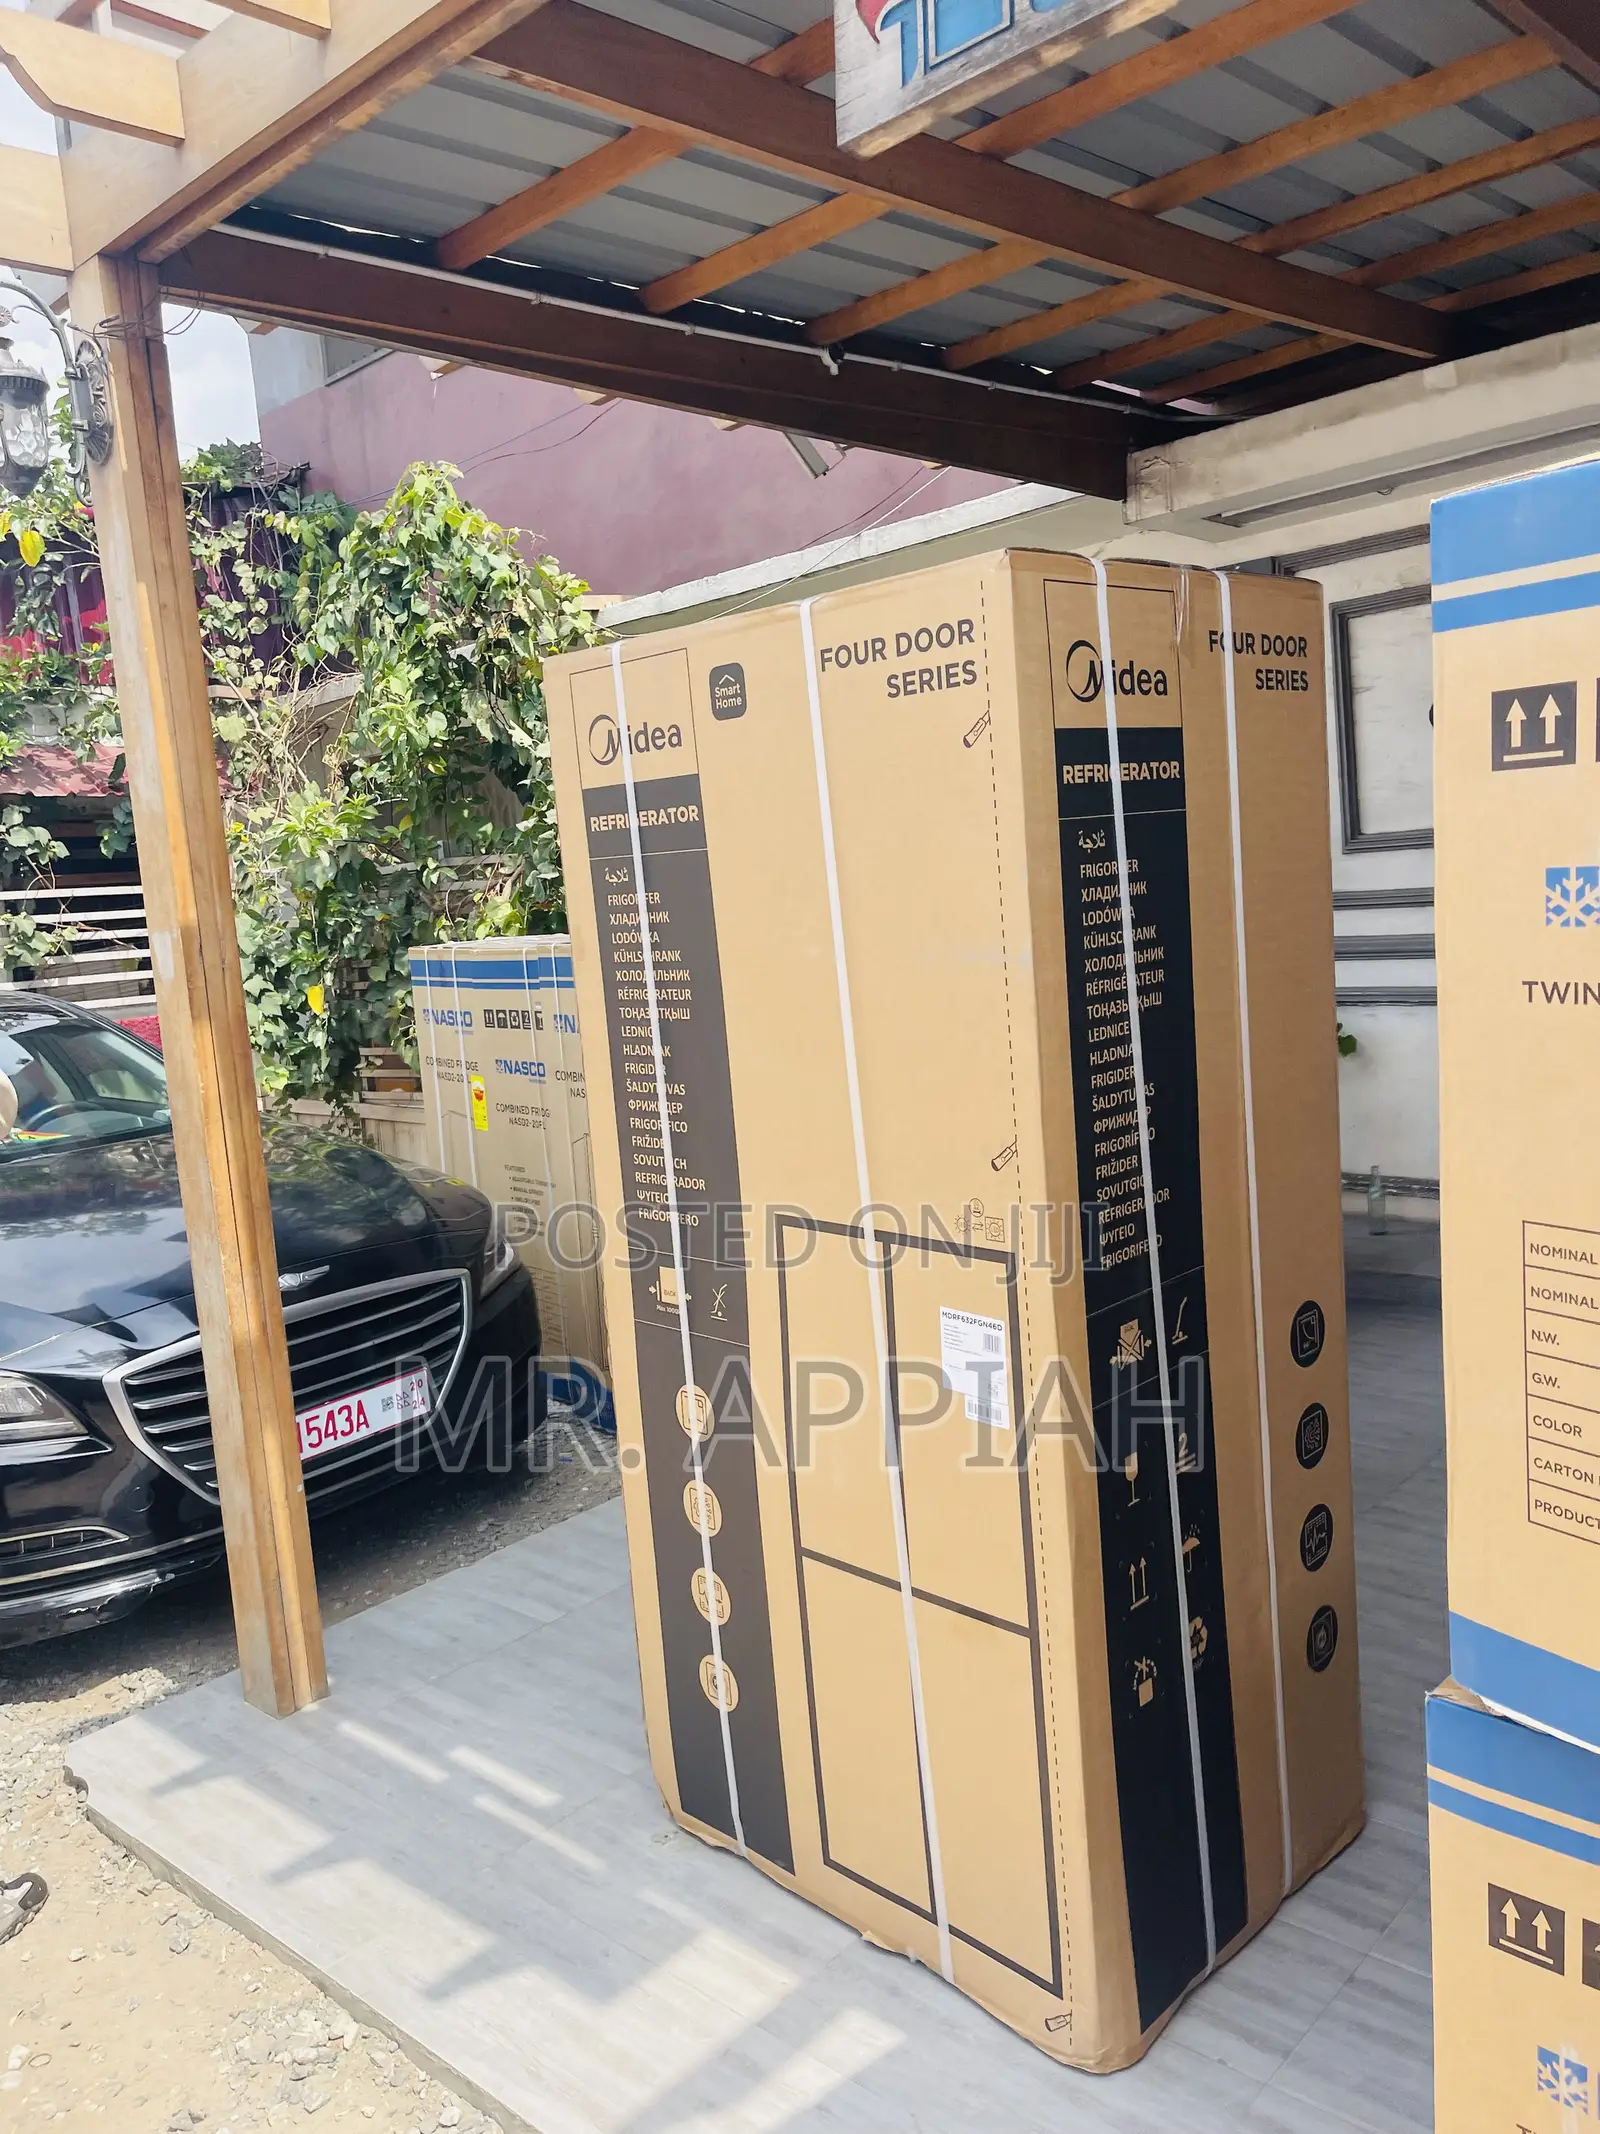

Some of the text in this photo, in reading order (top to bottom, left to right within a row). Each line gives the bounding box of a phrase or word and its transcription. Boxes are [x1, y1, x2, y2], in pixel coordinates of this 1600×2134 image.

[820, 618, 975, 672] FOUR DOOR
[1261, 634, 1307, 658] DOOR
[887, 660, 977, 698] SERIES
[1066, 640, 1168, 702] Midea
[1256, 668, 1309, 691] SERIES
[714, 682, 741, 699] Smart
[715, 694, 743, 710] Home
[588, 714, 683, 766] Midea
[1062, 761, 1180, 785] REFRIERATOR
[590, 804, 700, 833] REFRIERATOR
[1080, 859, 1139, 878] FRIGORER
[1081, 881, 1148, 903] ХЛАДИНИК
[1082, 904, 1136, 926] LODÓWA
[1083, 925, 1157, 950] KÜHLSCRANK
[614, 949, 682, 963] KÜHLSHRANK
[618, 986, 692, 1001] RÉFRIGRATEUR
[1086, 969, 1165, 997] RÉFRIGÉATEUR
[1521, 980, 1600, 1006] TWIN
[621, 1025, 653, 1038] LEDNIC
[1088, 1021, 1130, 1043] LEDNICE
[623, 1044, 671, 1058] HLADNK
[1089, 1043, 1135, 1066] HLADNJA
[503, 1060, 546, 1078] NASCO
[555, 1070, 586, 1083] COMBIN
[626, 1078, 686, 1096] ŠALDYTVAS
[1092, 1082, 1155, 1112] ŠALDYTUAS
[496, 1102, 530, 1116] COMBINED
[1094, 1106, 1152, 1134] ФРИЖИДР
[631, 1134, 665, 1150] FRIŽIDE
[1095, 1128, 1156, 1157] FRIGORÍFO
[633, 1153, 687, 1170] SOVUTCH
[1096, 1154, 1139, 1180] FRIŽIDER
[635, 1171, 706, 1191] REFRIGRADOR
[1097, 1175, 1146, 1203] SOVUTGIC
[1101, 1234, 1163, 1271] FRIGORIFEO
[1529, 1243, 1599, 1266] NOMINAL
[1530, 1286, 1600, 1311] NOMINAL
[1531, 1329, 1560, 1346] N.W.
[1532, 1372, 1561, 1389] G.W.
[1532, 1414, 1583, 1438] COLOR
[1533, 1457, 1594, 1485] CARTON
[1534, 1498, 1600, 1530] PRODUCT
